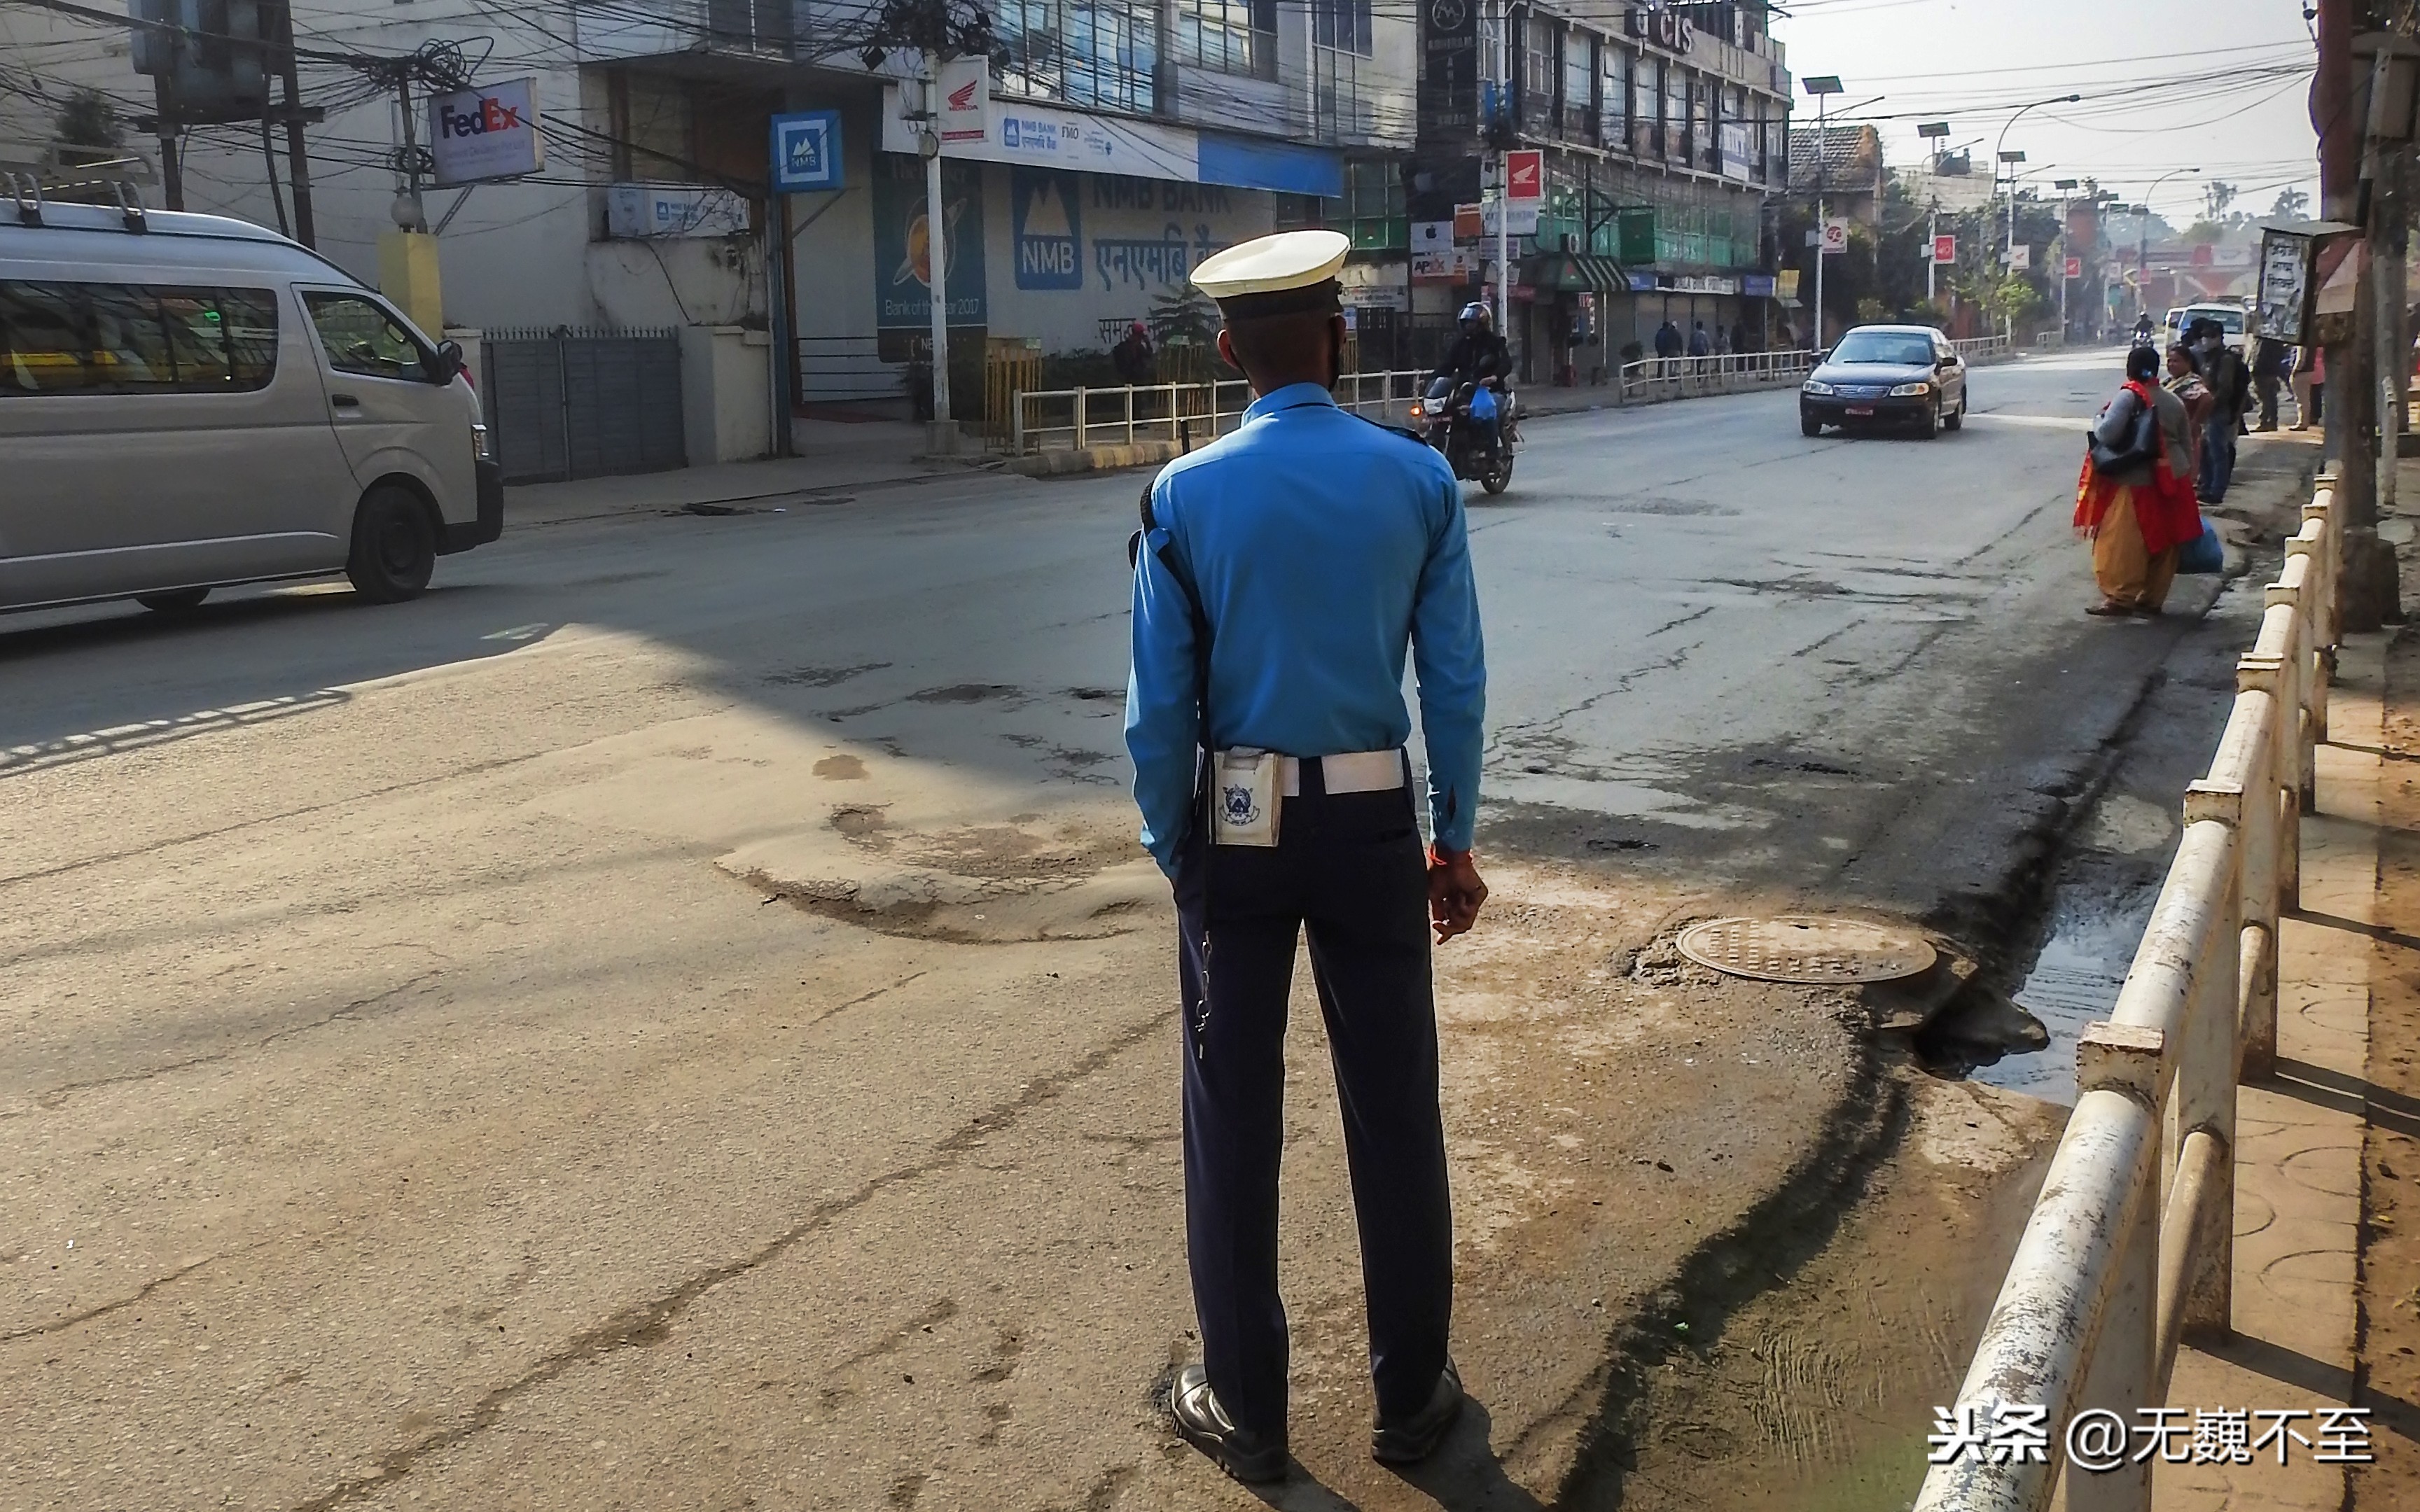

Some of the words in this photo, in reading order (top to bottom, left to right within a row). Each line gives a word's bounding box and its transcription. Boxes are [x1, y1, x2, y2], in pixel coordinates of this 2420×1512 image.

[440, 97, 520, 139] FedEx
[1062, 126, 1079, 139] FMO
[791, 156, 816, 167] NMB
[1093, 174, 1154, 209] NMB
[1162, 179, 1231, 214] BANK
[1022, 241, 1074, 275] NMB
[885, 299, 910, 316] Bank
[911, 299, 921, 316] of
[958, 298, 979, 314] 2017
